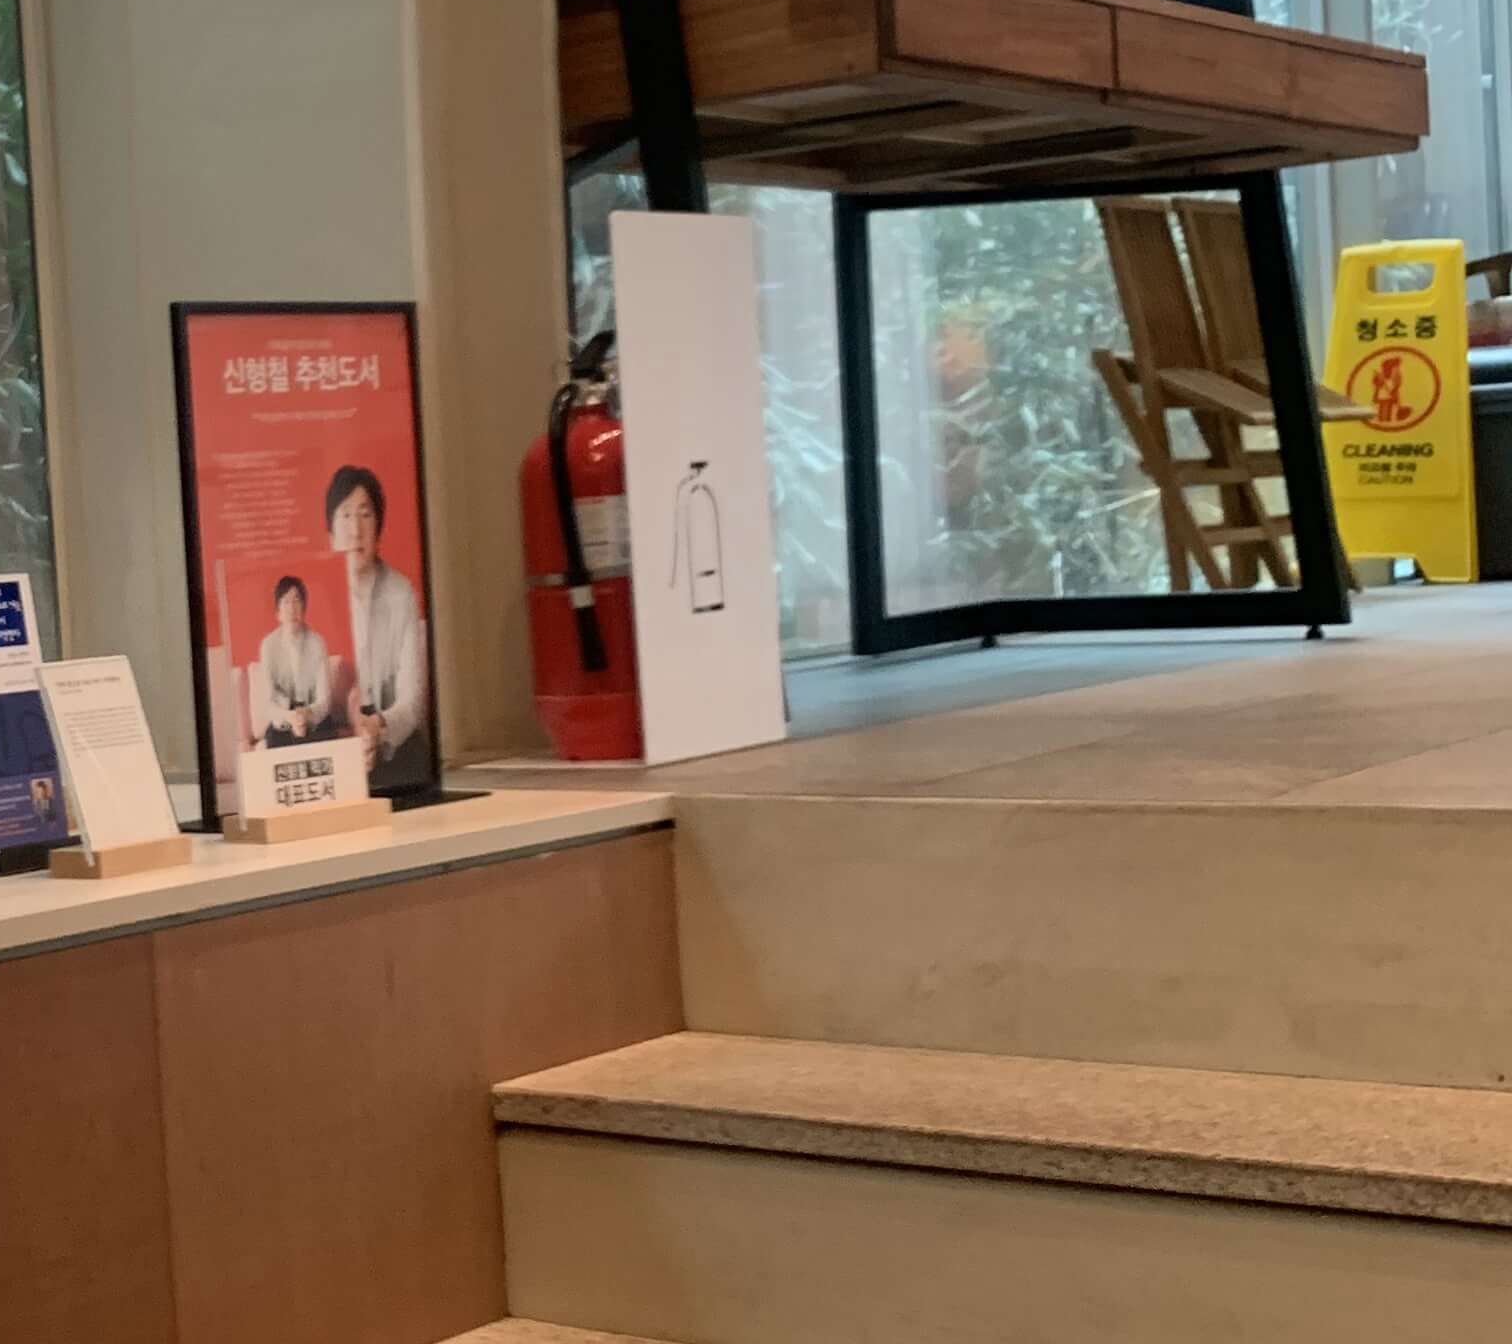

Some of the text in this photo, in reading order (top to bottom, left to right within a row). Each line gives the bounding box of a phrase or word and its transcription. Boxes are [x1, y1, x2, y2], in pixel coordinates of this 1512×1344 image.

[1356, 315, 1437, 342] 청소중
[224, 354, 380, 394] 신형철 추천도서
[1342, 443, 1434, 458] CLEANING
[276, 779, 336, 807] 대표도서
